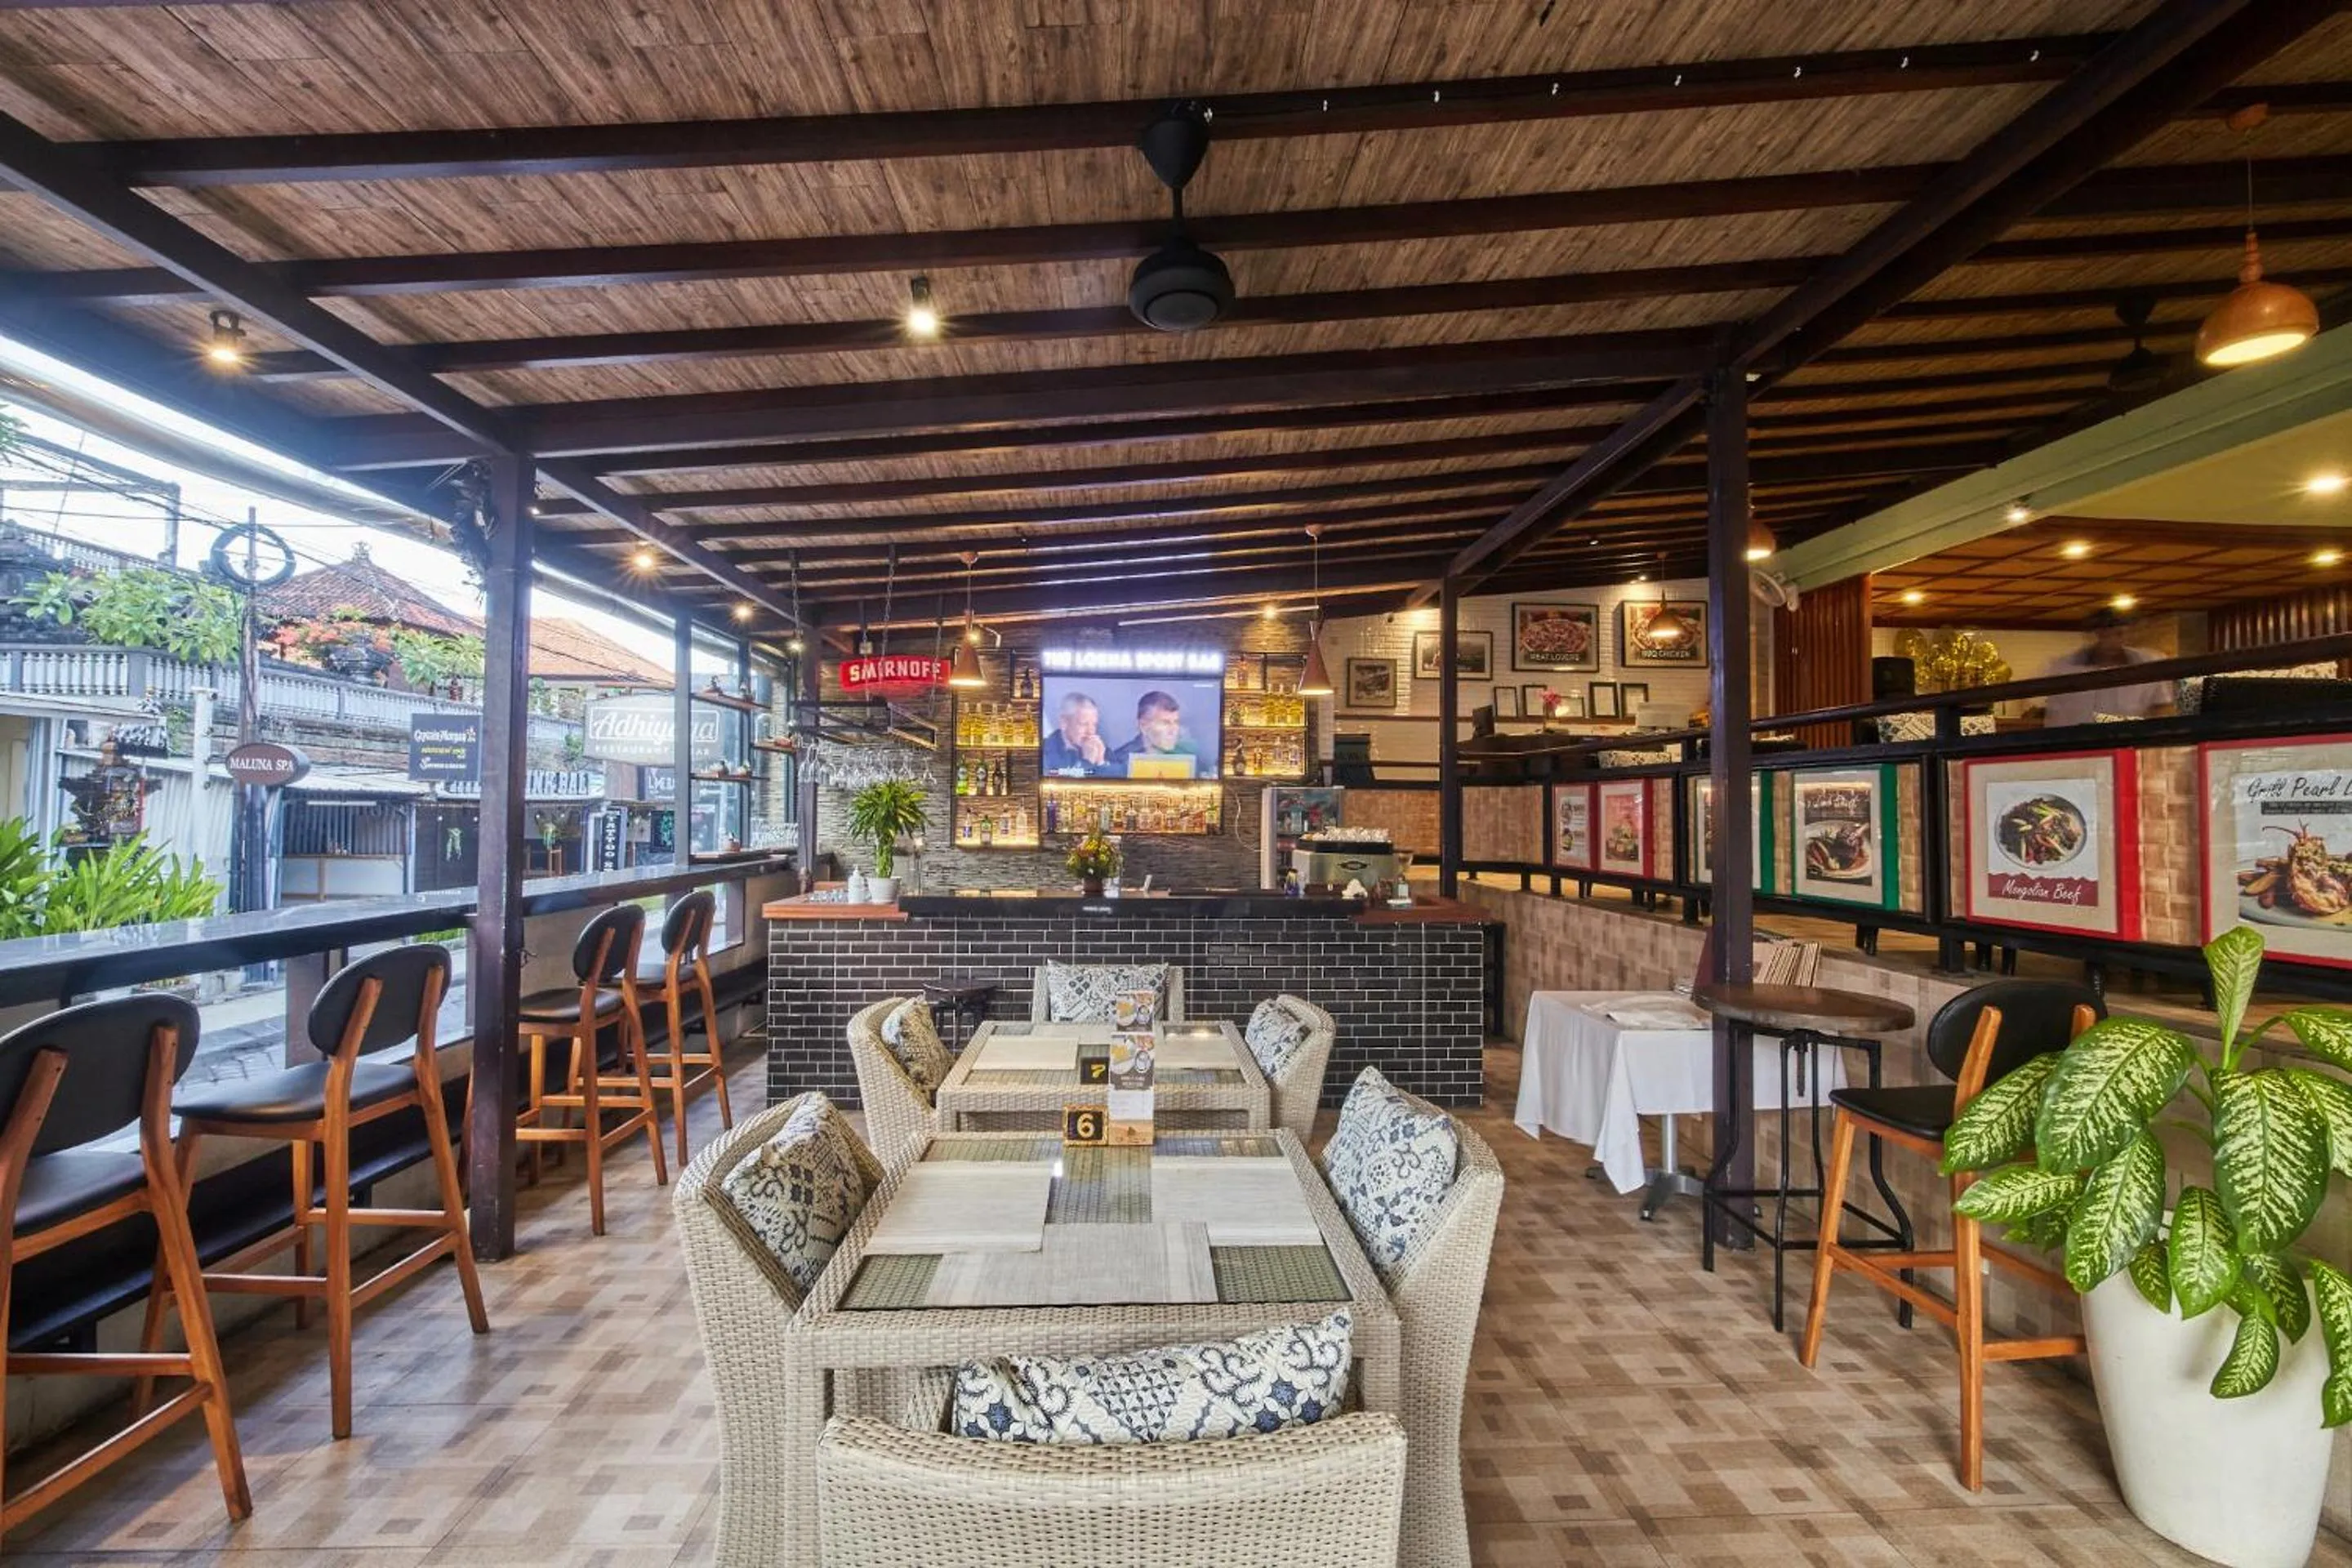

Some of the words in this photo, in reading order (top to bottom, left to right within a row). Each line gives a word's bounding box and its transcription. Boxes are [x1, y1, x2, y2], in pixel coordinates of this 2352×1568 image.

[229, 756, 273, 771] MALUNA
[276, 759, 294, 773] SPA
[2290, 775, 2341, 797] Pearl
[2001, 880, 2050, 901] Mongolian
[2053, 883, 2082, 906] Beef
[1090, 1064, 1106, 1078] 7
[1076, 1112, 1095, 1138] 6
